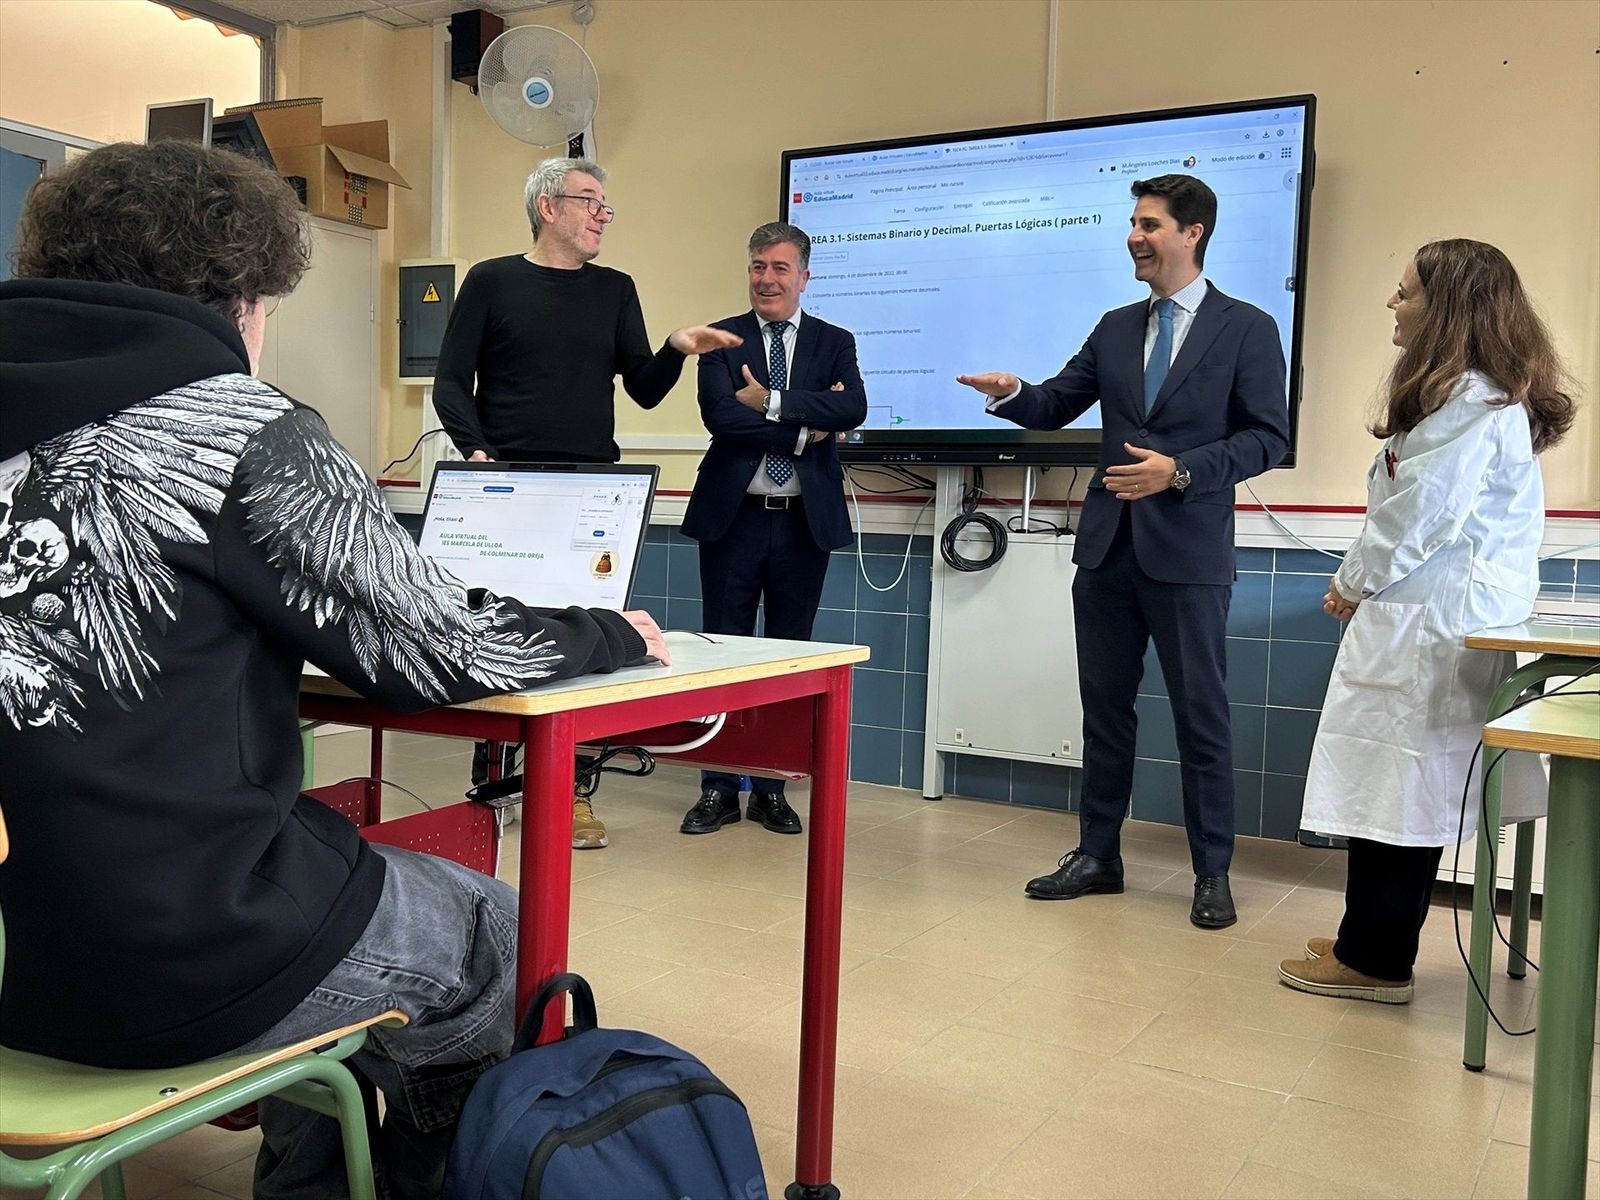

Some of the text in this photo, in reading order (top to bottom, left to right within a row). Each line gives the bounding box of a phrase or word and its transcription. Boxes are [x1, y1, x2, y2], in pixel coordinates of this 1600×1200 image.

[1234, 153, 1256, 161] edición
[917, 183, 937, 191] personal
[814, 194, 853, 202] EducaMadrid
[810, 234, 828, 245] REA
[830, 234, 846, 243] 3.1-
[847, 229, 887, 242] Sistemas
[889, 227, 922, 239] Binario
[923, 228, 930, 238] y
[932, 223, 973, 235] Decimal.
[975, 221, 1013, 233] Puertas
[1015, 218, 1053, 231] Lógicas
[1060, 215, 1089, 228] parte
[1092, 213, 1102, 224] 1)
